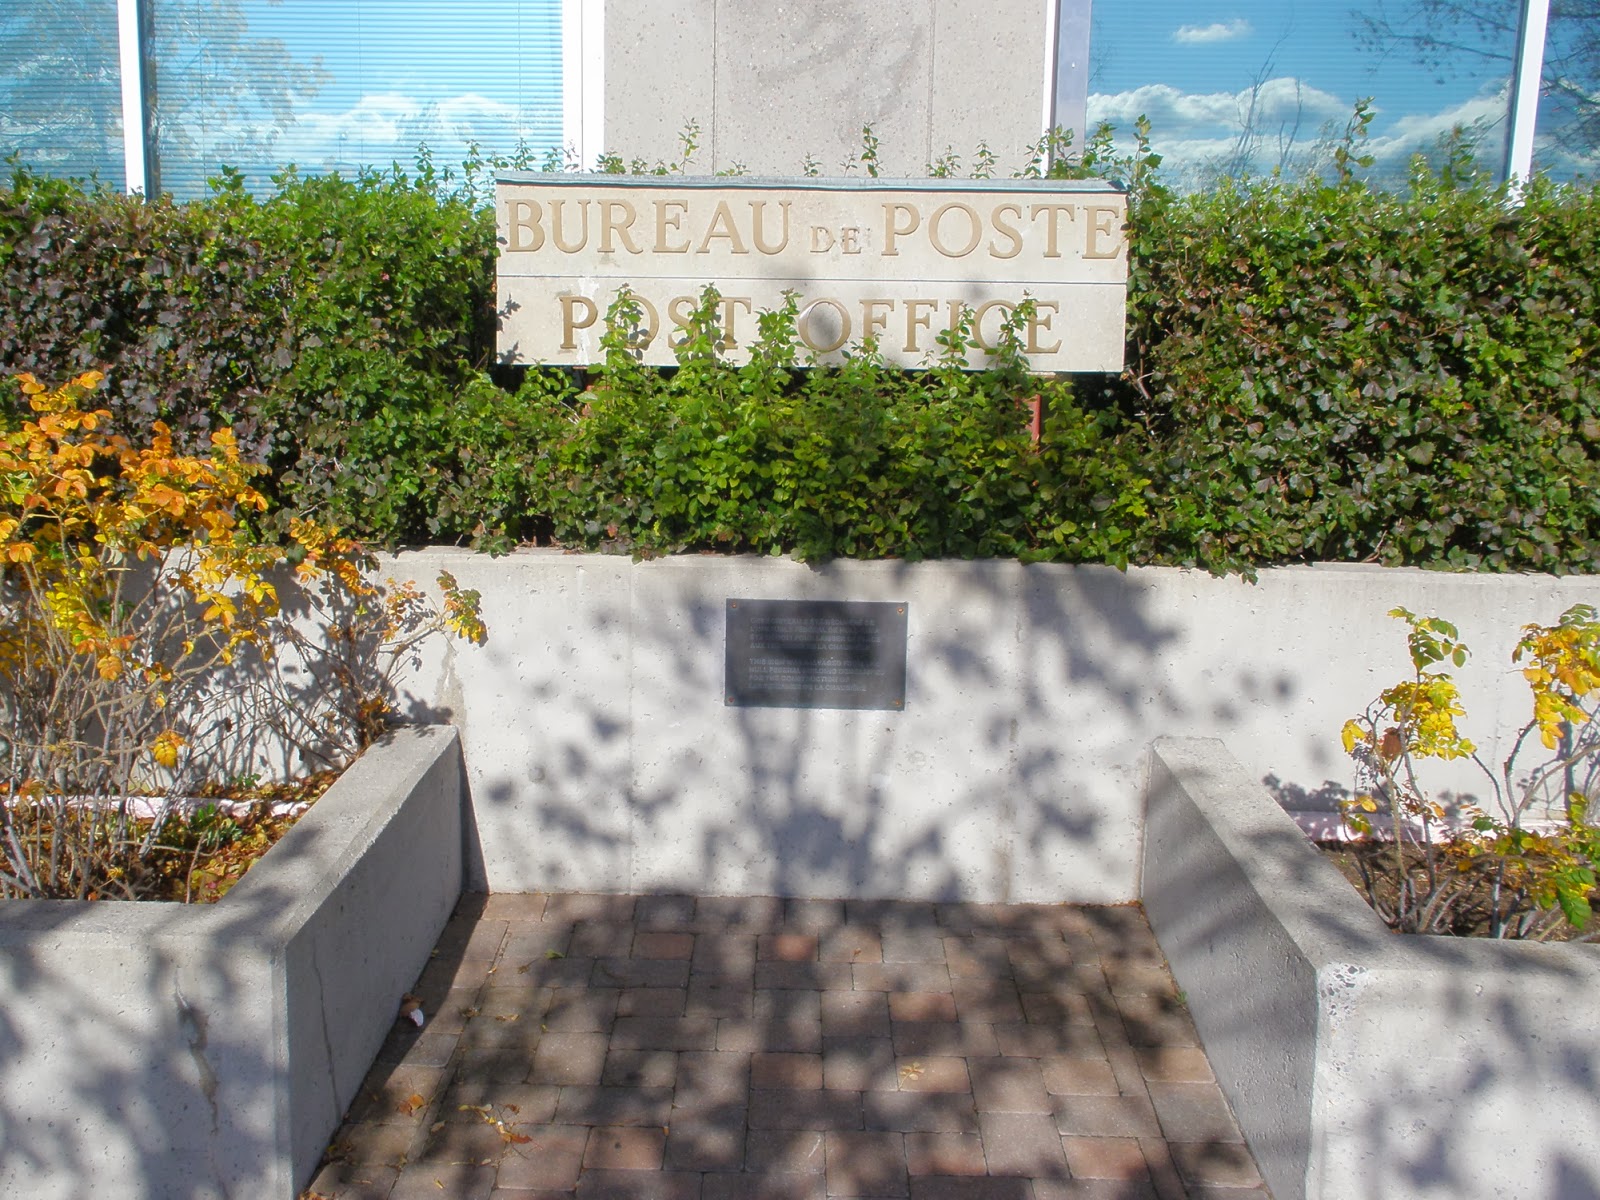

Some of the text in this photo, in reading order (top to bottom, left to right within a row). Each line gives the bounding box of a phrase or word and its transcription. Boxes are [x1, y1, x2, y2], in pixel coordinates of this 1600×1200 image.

[504, 199, 1122, 259] BUREAU DE POSTE
[559, 295, 1062, 354] POST OFFICE
